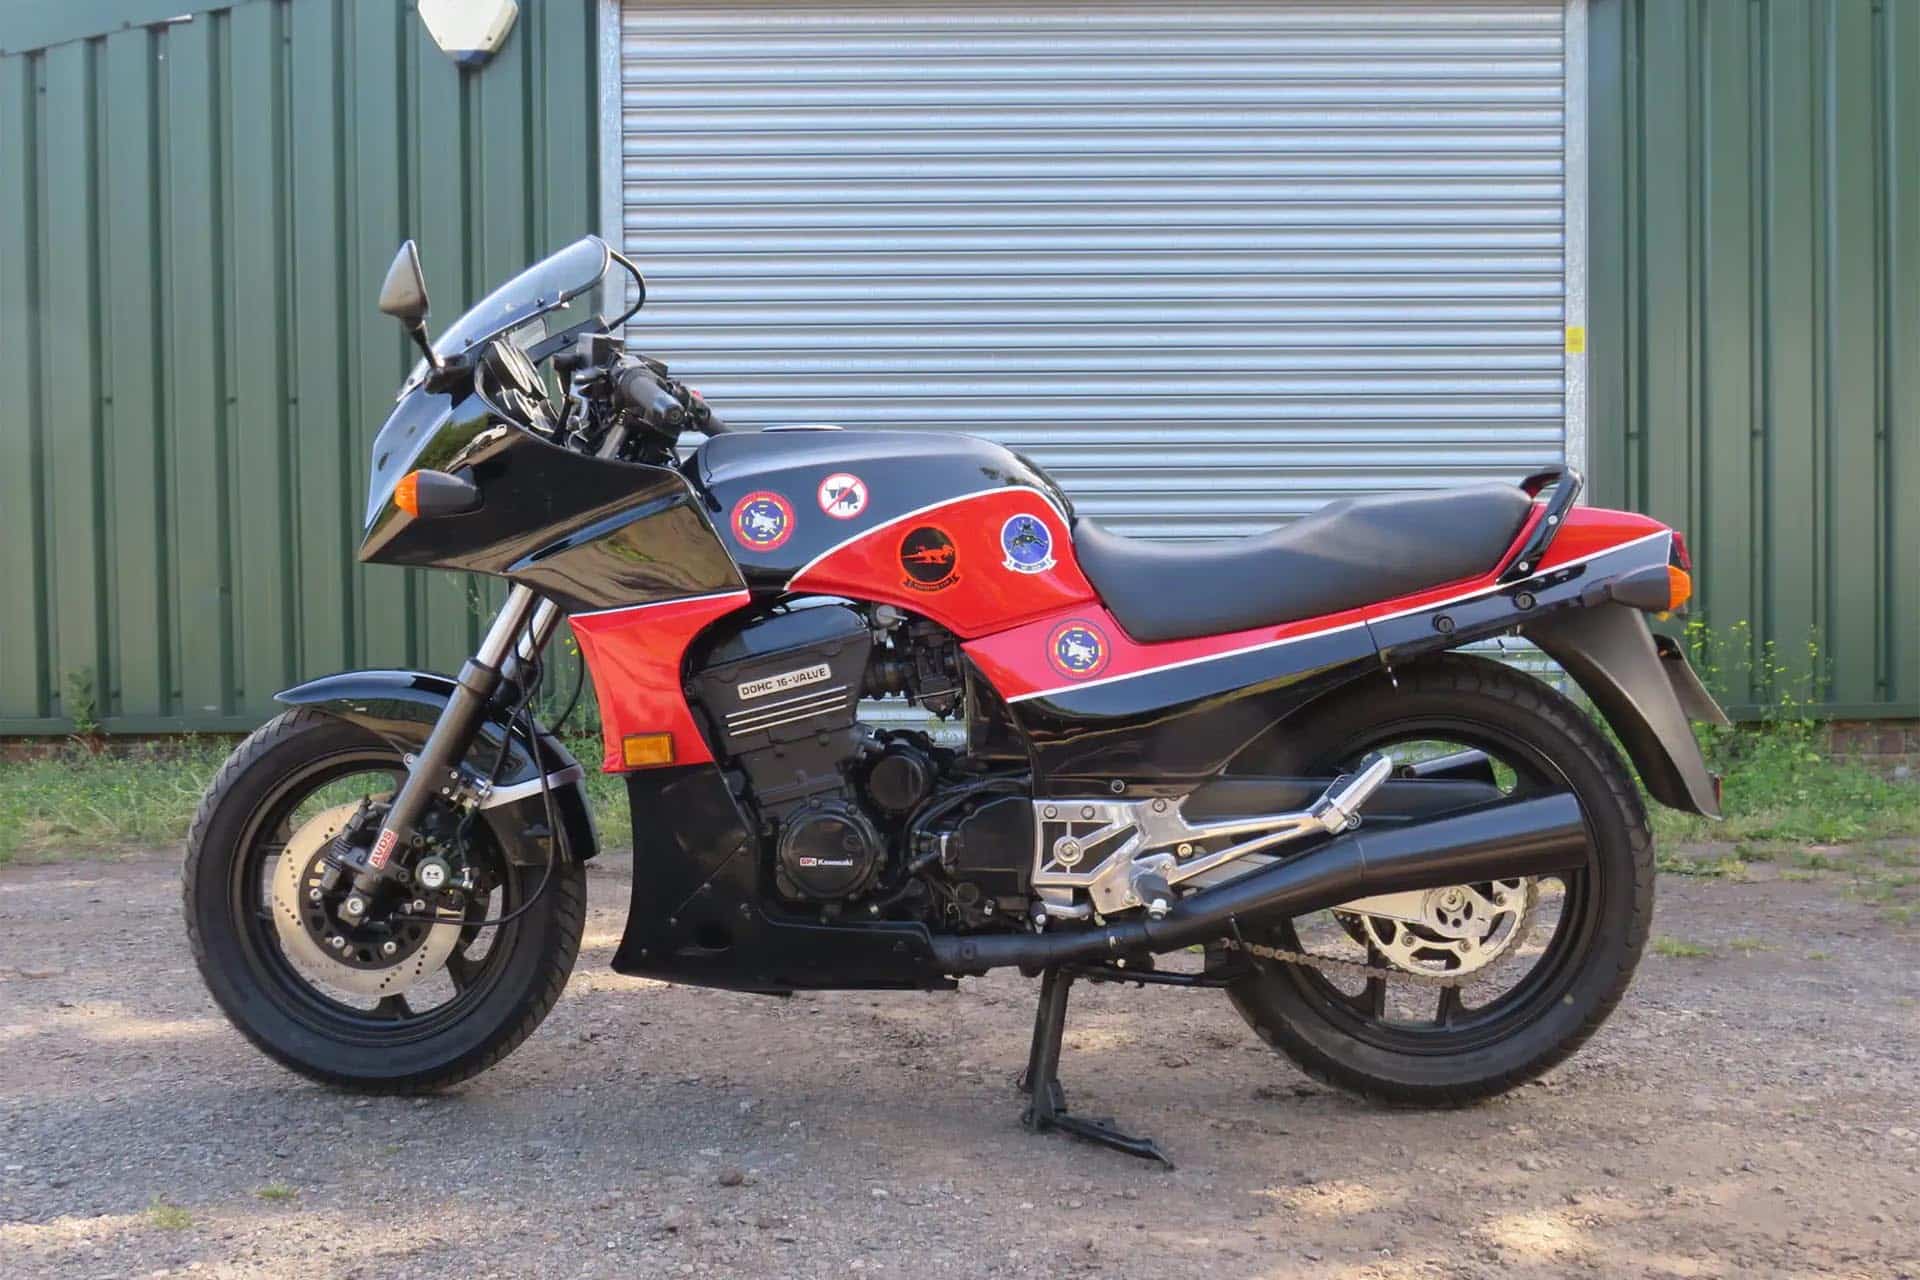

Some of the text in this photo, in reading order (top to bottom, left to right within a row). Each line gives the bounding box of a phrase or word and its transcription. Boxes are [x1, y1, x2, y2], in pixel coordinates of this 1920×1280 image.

[742, 668, 826, 696] DOHC 16-VALVE
[372, 831, 392, 866] AVDS
